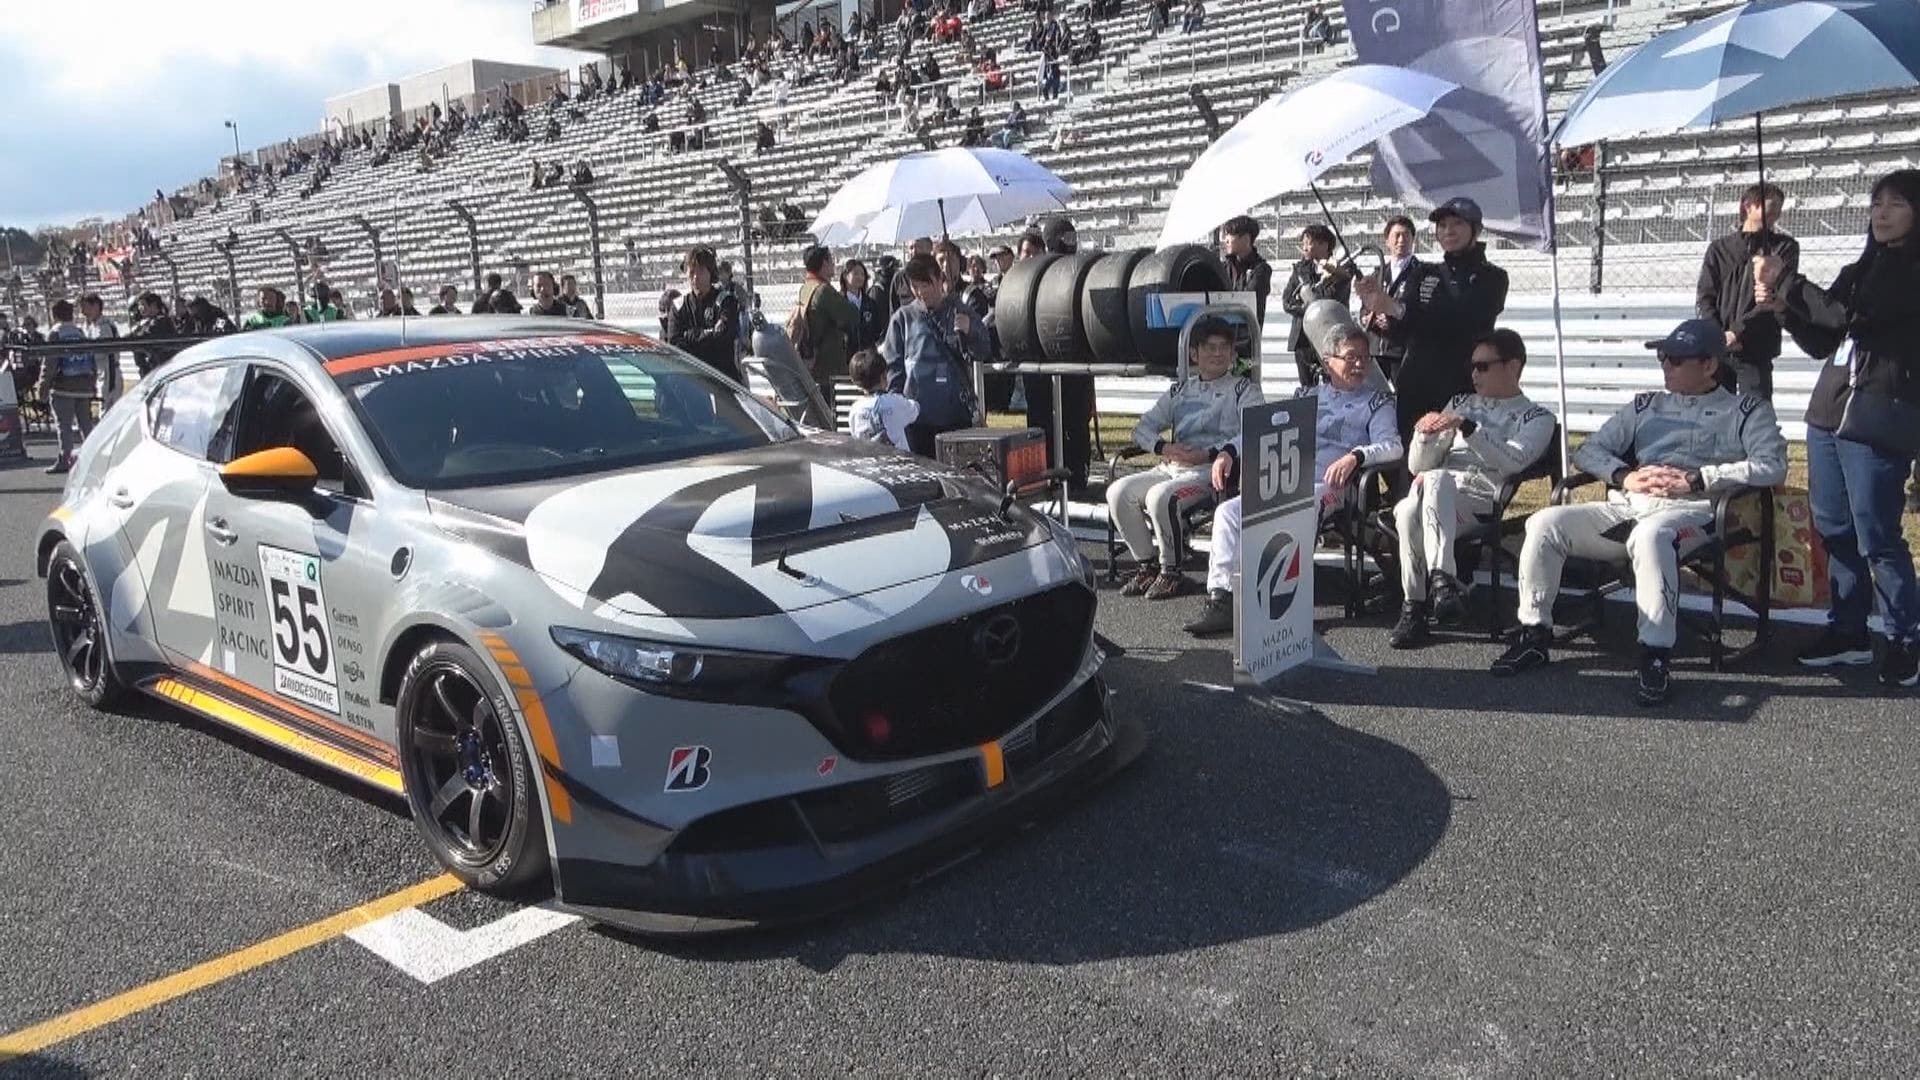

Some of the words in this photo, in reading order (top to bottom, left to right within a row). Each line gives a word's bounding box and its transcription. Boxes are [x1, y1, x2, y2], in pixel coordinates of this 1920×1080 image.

[373, 351, 492, 378] MAZDA
[497, 345, 578, 361] SPIRIT
[1259, 427, 1300, 501] 55
[214, 559, 259, 589] MAZDA
[307, 562, 317, 582] Q
[218, 592, 255, 621] SPIRIT
[270, 577, 329, 675] 55
[1263, 626, 1294, 649] MAZDA
[221, 626, 268, 660] RACING
[1275, 636, 1308, 663] RACING
[280, 674, 334, 707] BRIDGESTONE
